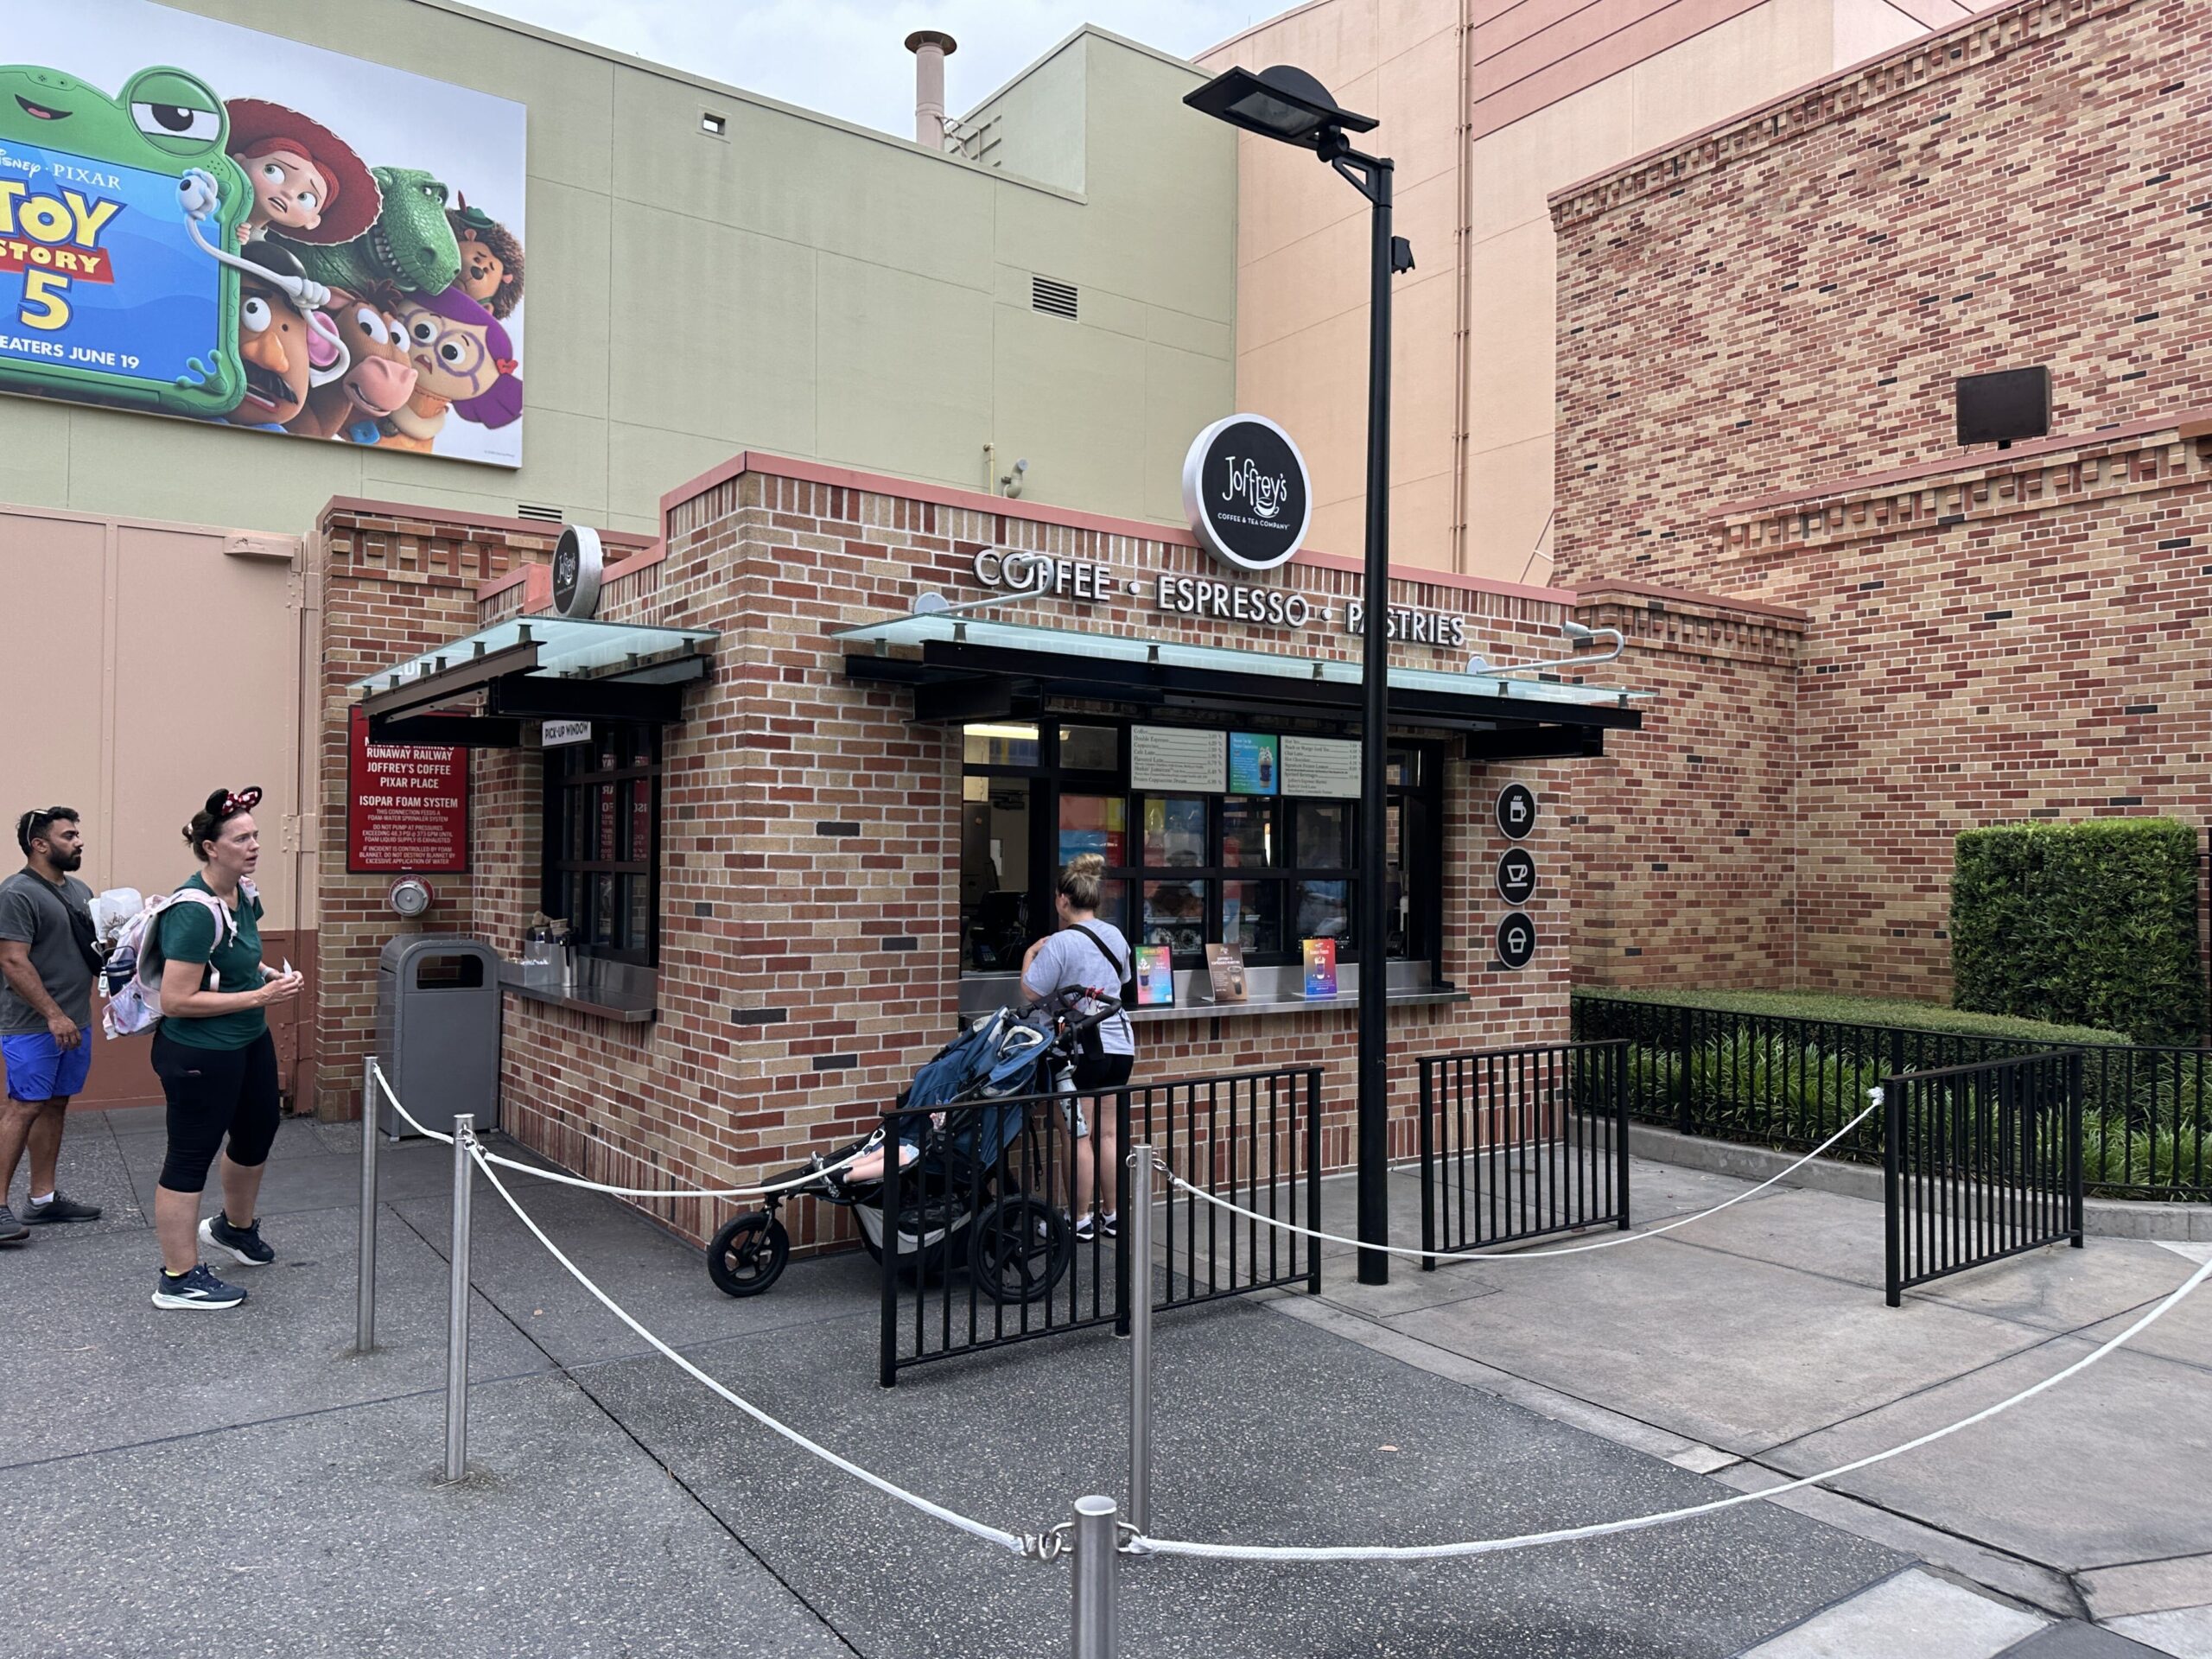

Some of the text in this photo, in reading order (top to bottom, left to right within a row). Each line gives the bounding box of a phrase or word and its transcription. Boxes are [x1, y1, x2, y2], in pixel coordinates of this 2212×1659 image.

[53, 162, 121, 190] PIXAR
[18, 264, 73, 331] 5
[69, 346, 115, 366] JUNE
[120, 354, 140, 370] 19
[1222, 455, 1287, 508] Joffrey's
[1217, 512, 1241, 524] COFFEE
[1248, 517, 1259, 526] TEA
[973, 548, 1465, 647] COFFEE ESPRESSO PSTRIES
[545, 721, 588, 741] PICK-UP WINDOW
[366, 747, 453, 761] RUNAWAY RAILWAY
[366, 761, 451, 775] JOFFREY'S COFFEE
[380, 777, 439, 789] PIXAR PLACE
[359, 795, 458, 808] ISOPAR FOAM SYSTEM
